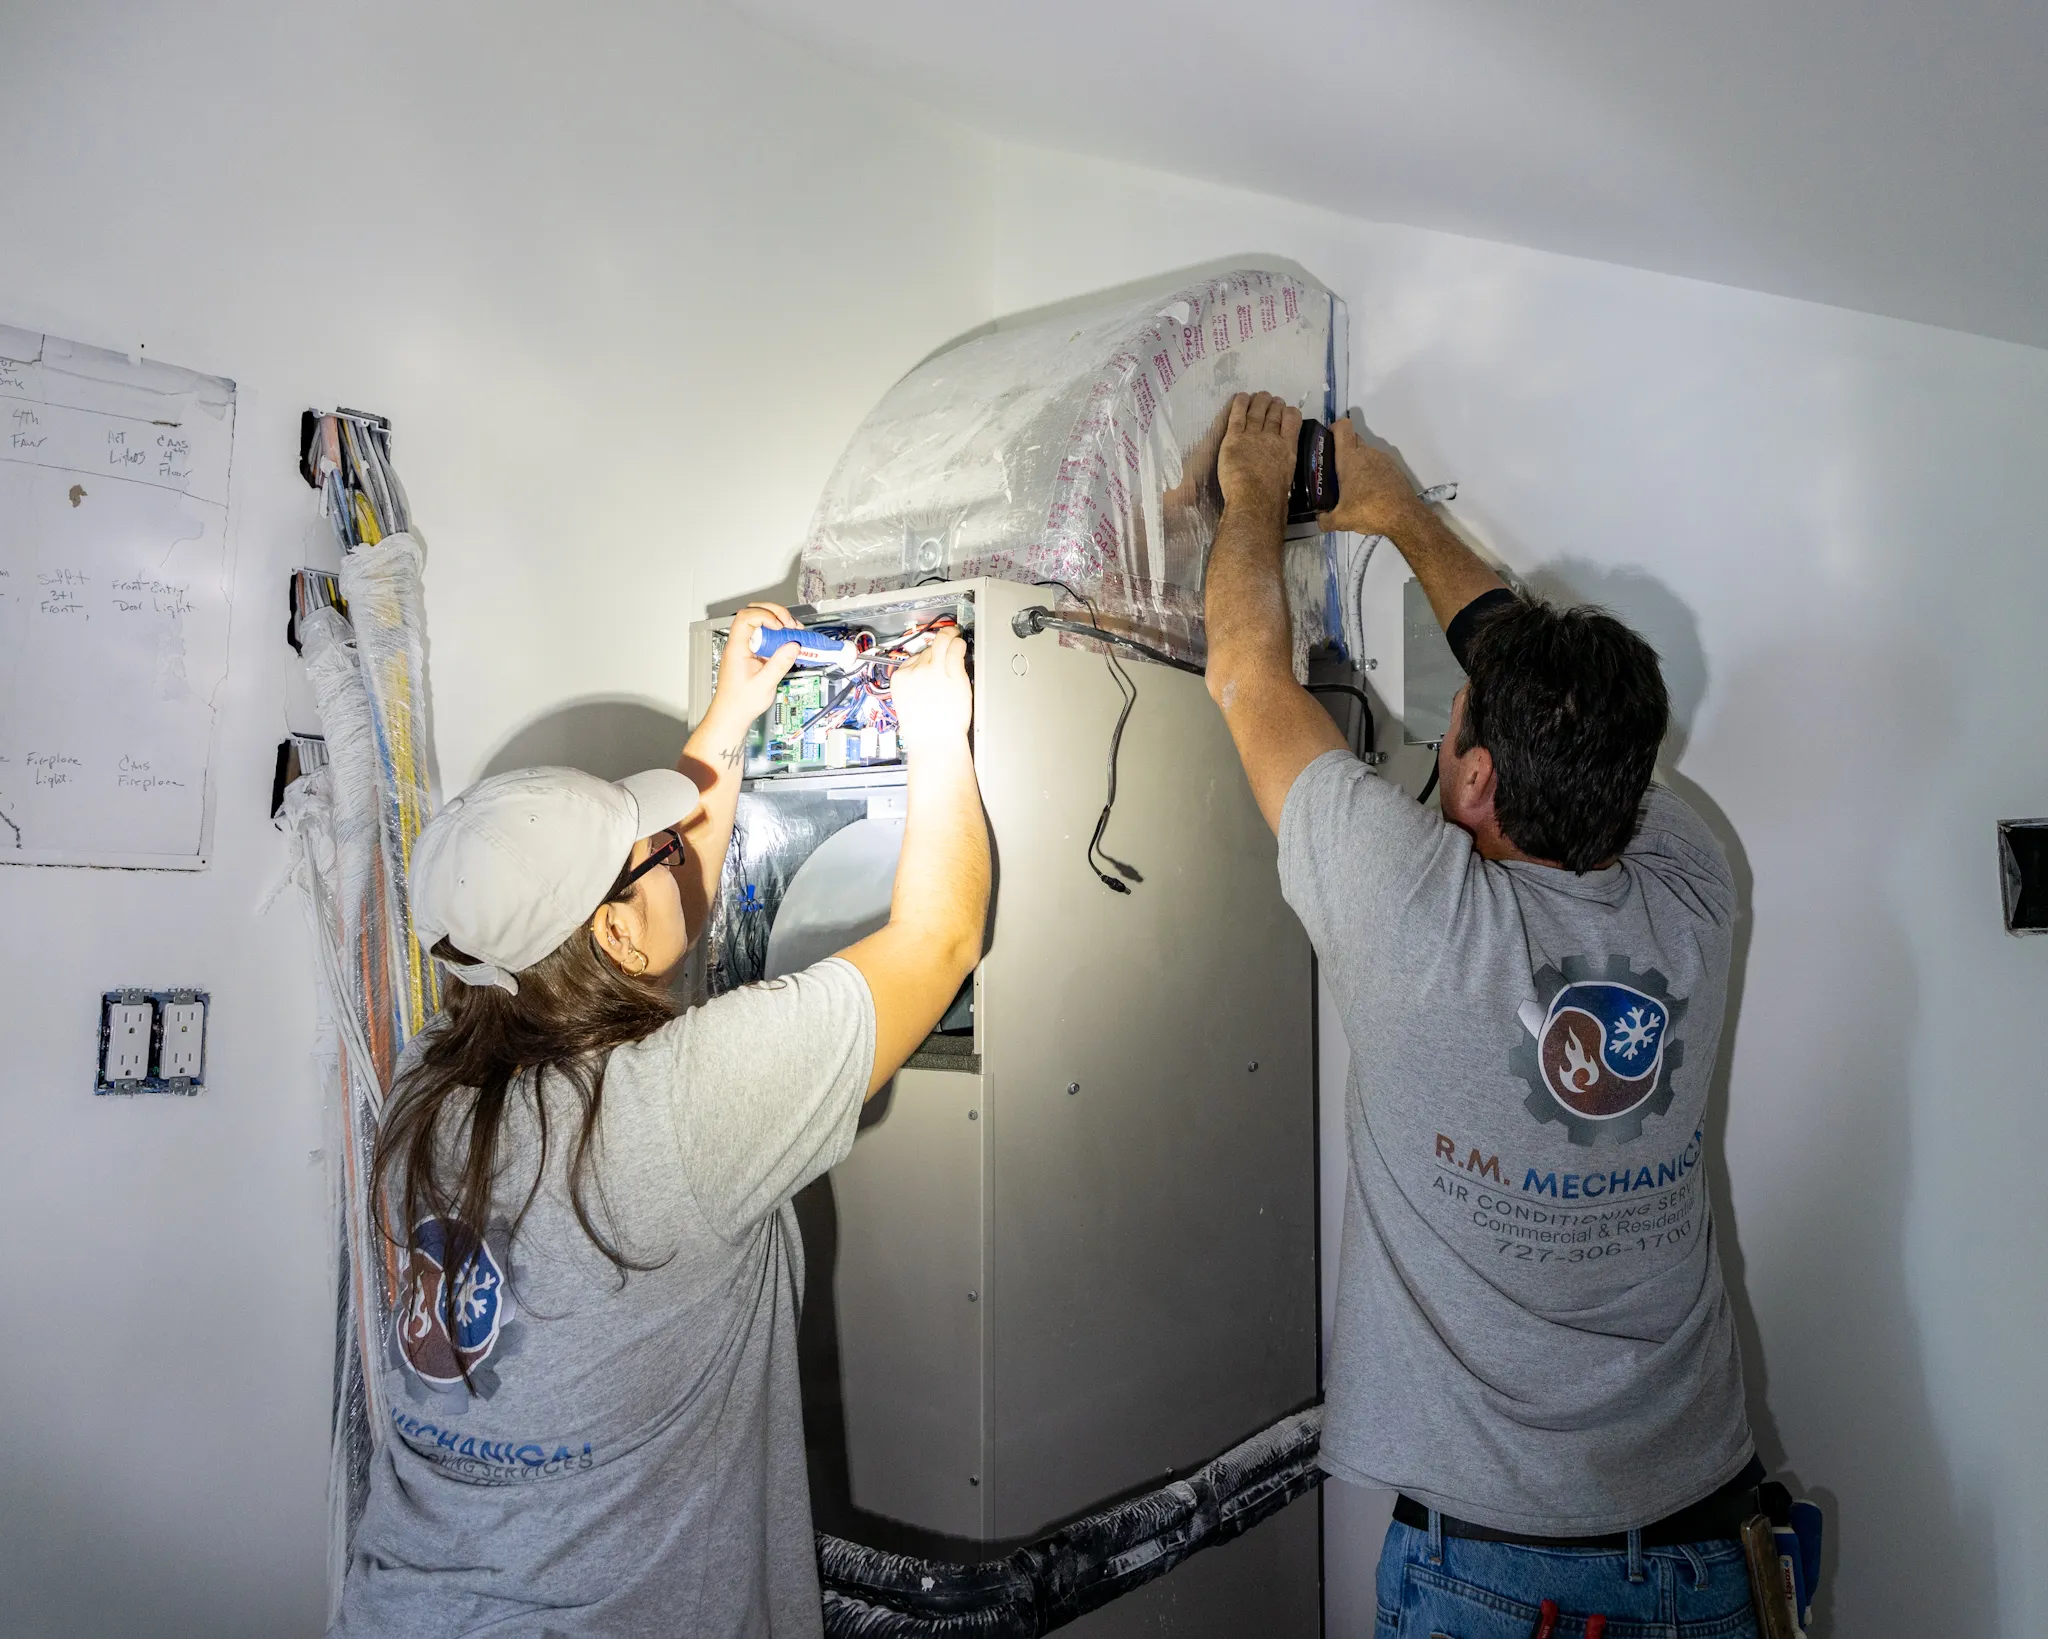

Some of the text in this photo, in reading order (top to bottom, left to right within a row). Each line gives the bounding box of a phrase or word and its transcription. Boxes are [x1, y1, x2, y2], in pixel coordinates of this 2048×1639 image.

[1435, 1130, 1702, 1199] R.M. MECHANIC
[1433, 1176, 1468, 1202] AIR
[1478, 1194, 1651, 1225] CONDITIONING
[1472, 1211, 1592, 1244] Commercial
[1599, 1226, 1612, 1239] &
[1495, 1220, 1692, 1264] 727-306-1700
